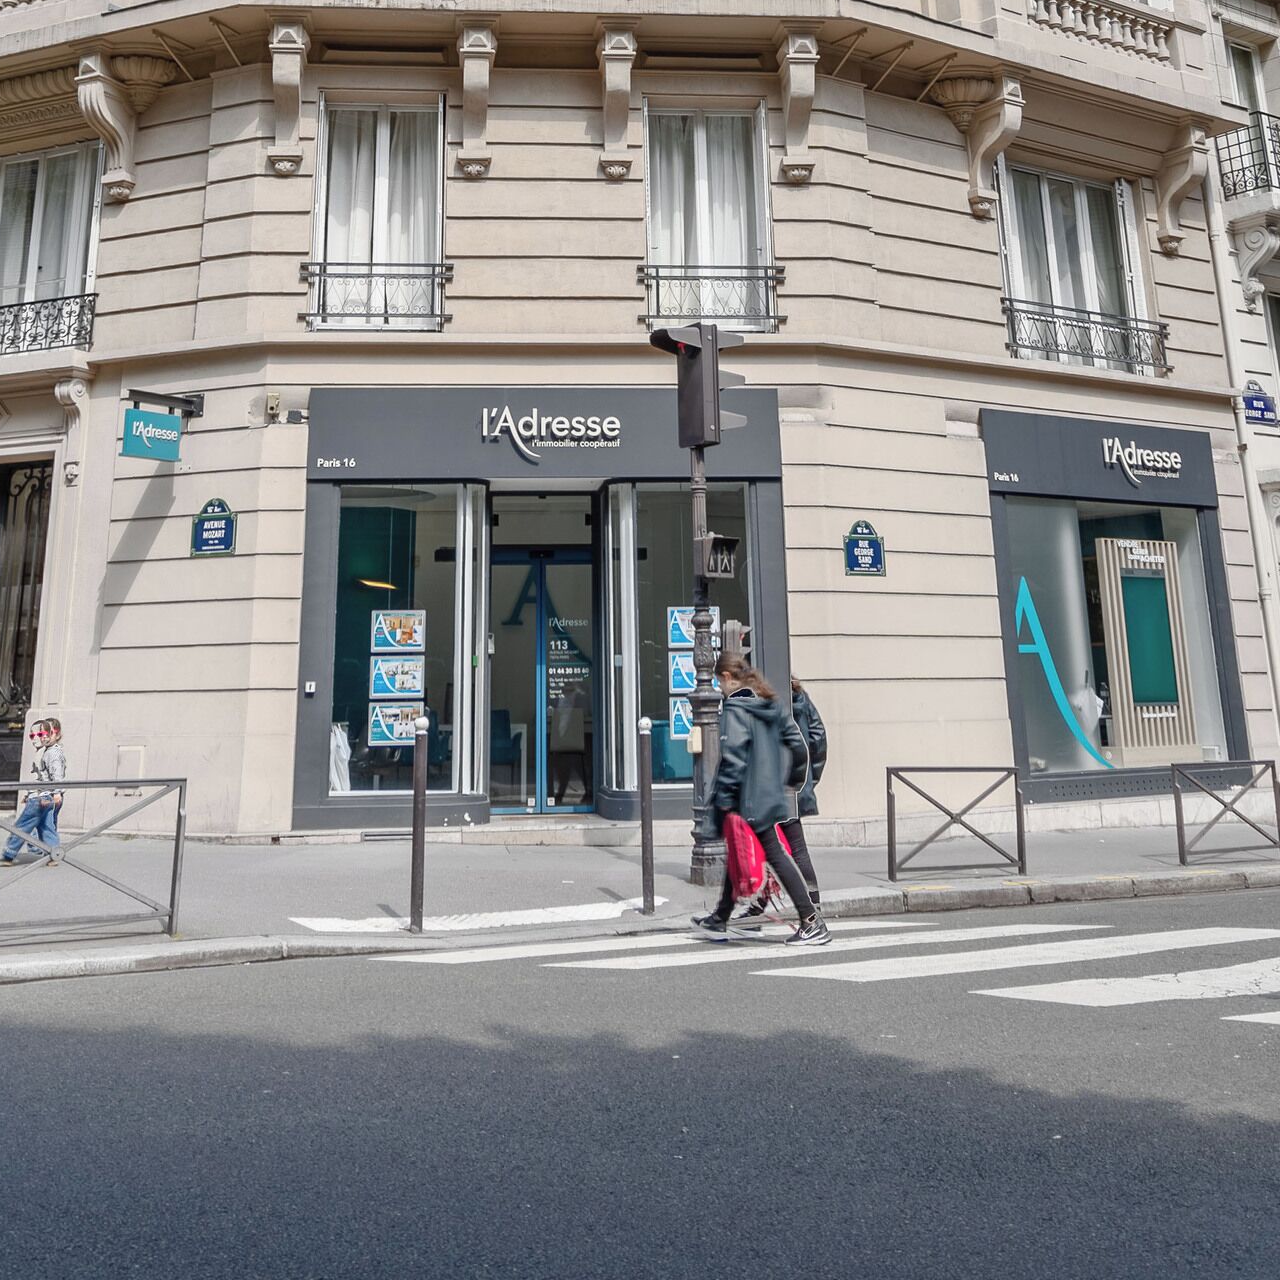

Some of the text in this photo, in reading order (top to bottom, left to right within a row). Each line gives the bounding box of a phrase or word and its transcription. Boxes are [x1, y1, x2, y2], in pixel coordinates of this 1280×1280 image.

[1245, 409, 1262, 418] EORGE
[132, 421, 178, 448] l'Adresse
[481, 405, 621, 458] l'Adresse
[579, 438, 621, 449] coopératif
[316, 458, 356, 468] Paris 16
[1102, 437, 1182, 484] l'Adresse
[993, 471, 1019, 482] Paris 16
[203, 520, 226, 529] AVENUE
[202, 530, 225, 539] MOZART
[858, 540, 870, 548] RUE
[854, 548, 875, 556] GEORGE
[858, 556, 872, 564] SAND
[550, 640, 568, 650] 113
